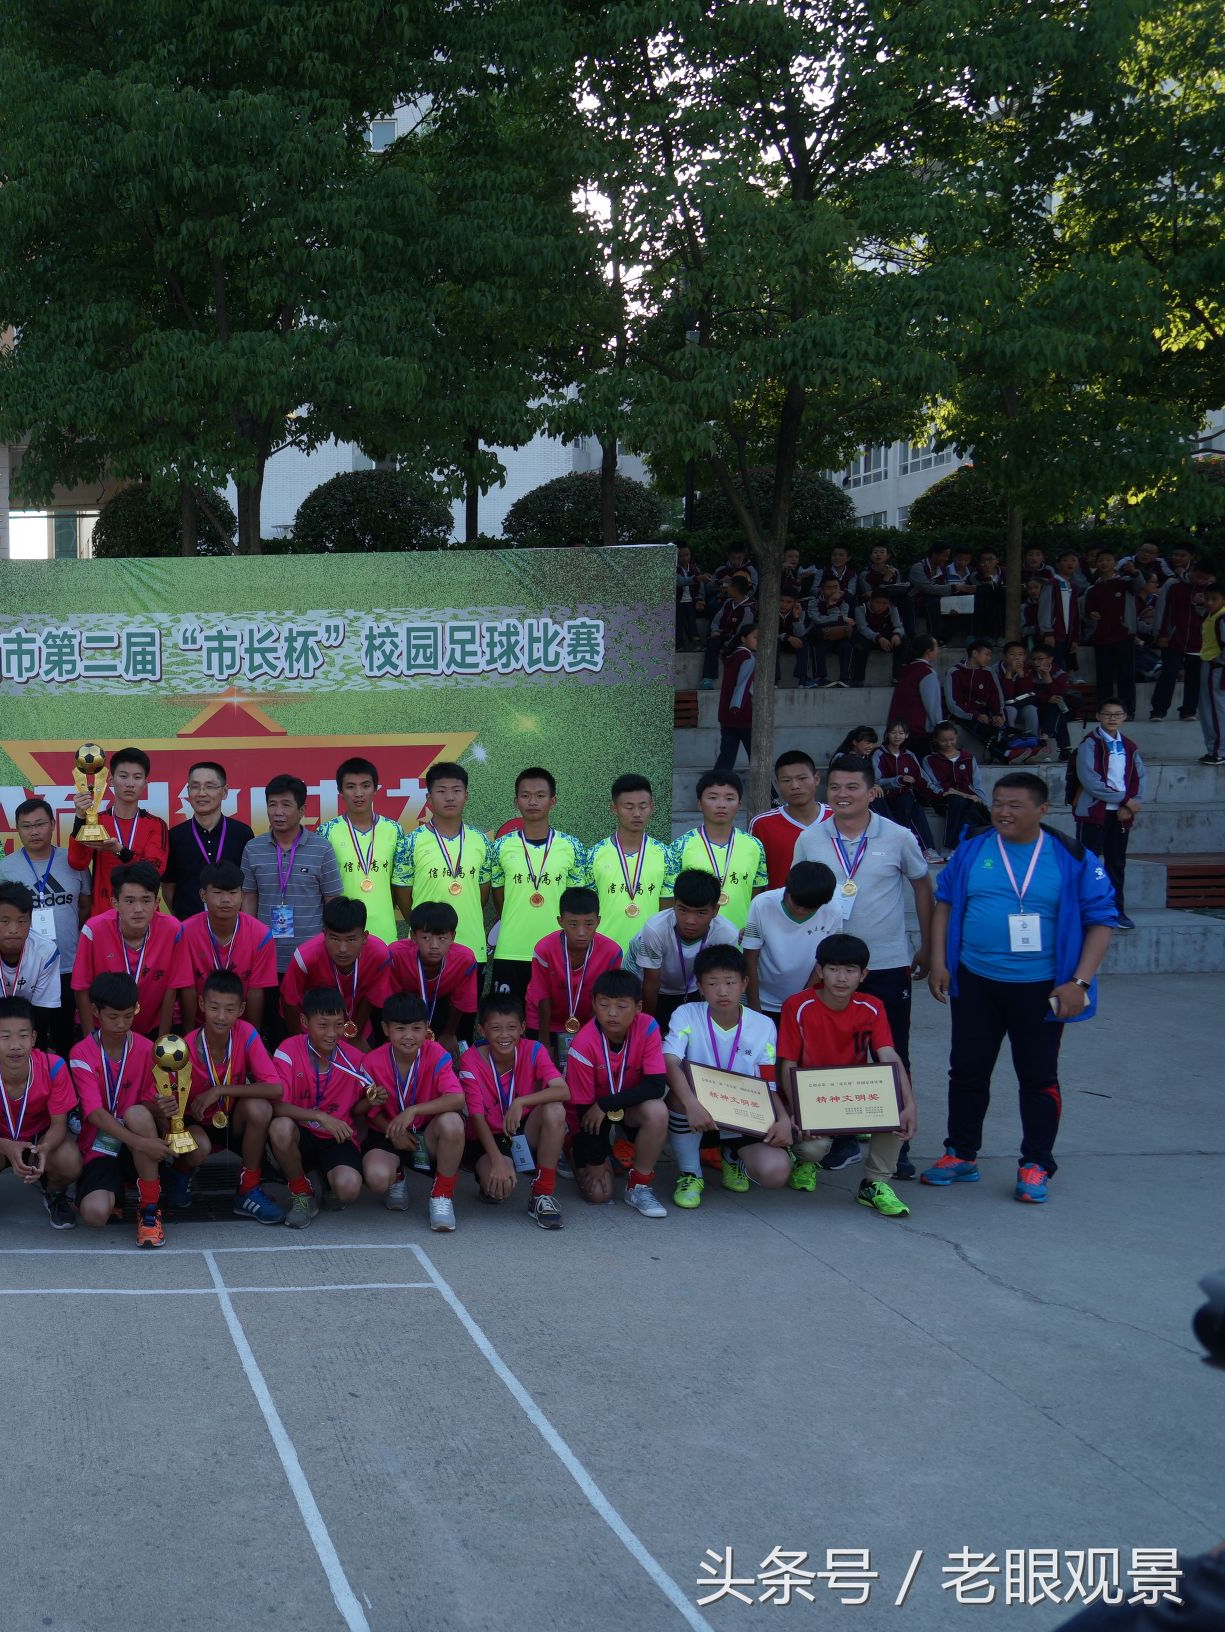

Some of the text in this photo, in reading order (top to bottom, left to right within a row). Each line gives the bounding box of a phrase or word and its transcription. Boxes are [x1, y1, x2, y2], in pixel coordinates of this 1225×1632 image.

[815, 1093, 880, 1104] 精神文明奖
